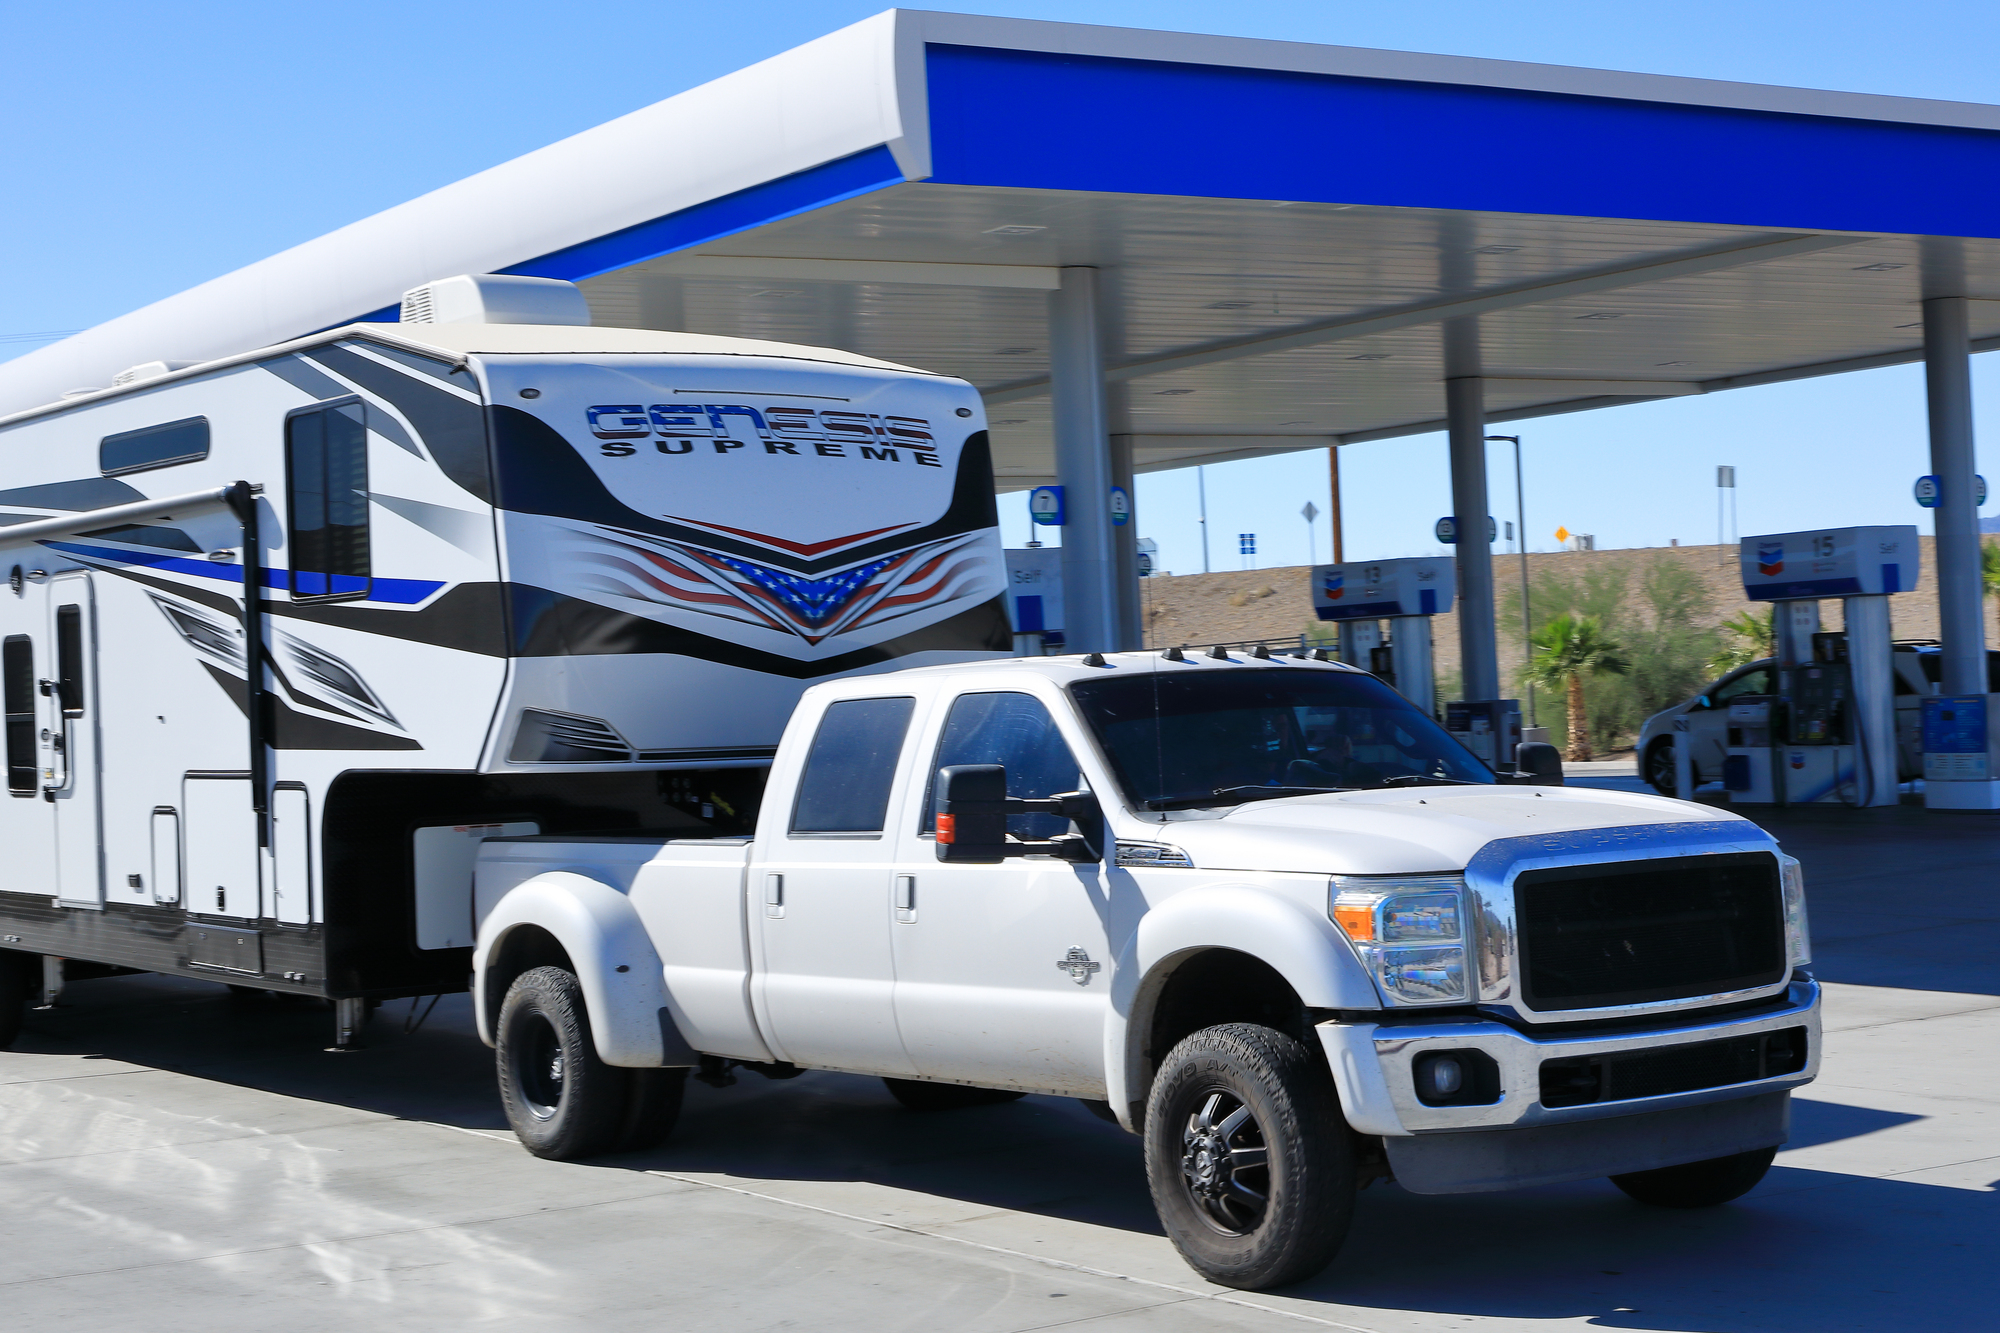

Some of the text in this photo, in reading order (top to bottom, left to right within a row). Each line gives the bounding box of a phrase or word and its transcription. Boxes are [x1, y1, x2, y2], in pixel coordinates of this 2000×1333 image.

[586, 404, 936, 451] GENESIS
[600, 440, 943, 468] SUPREME
[1039, 495, 1050, 511] 7
[1812, 535, 1835, 558] 15
[1878, 542, 1899, 555] Self
[1014, 569, 1042, 584] Self
[1364, 565, 1381, 585] 13
